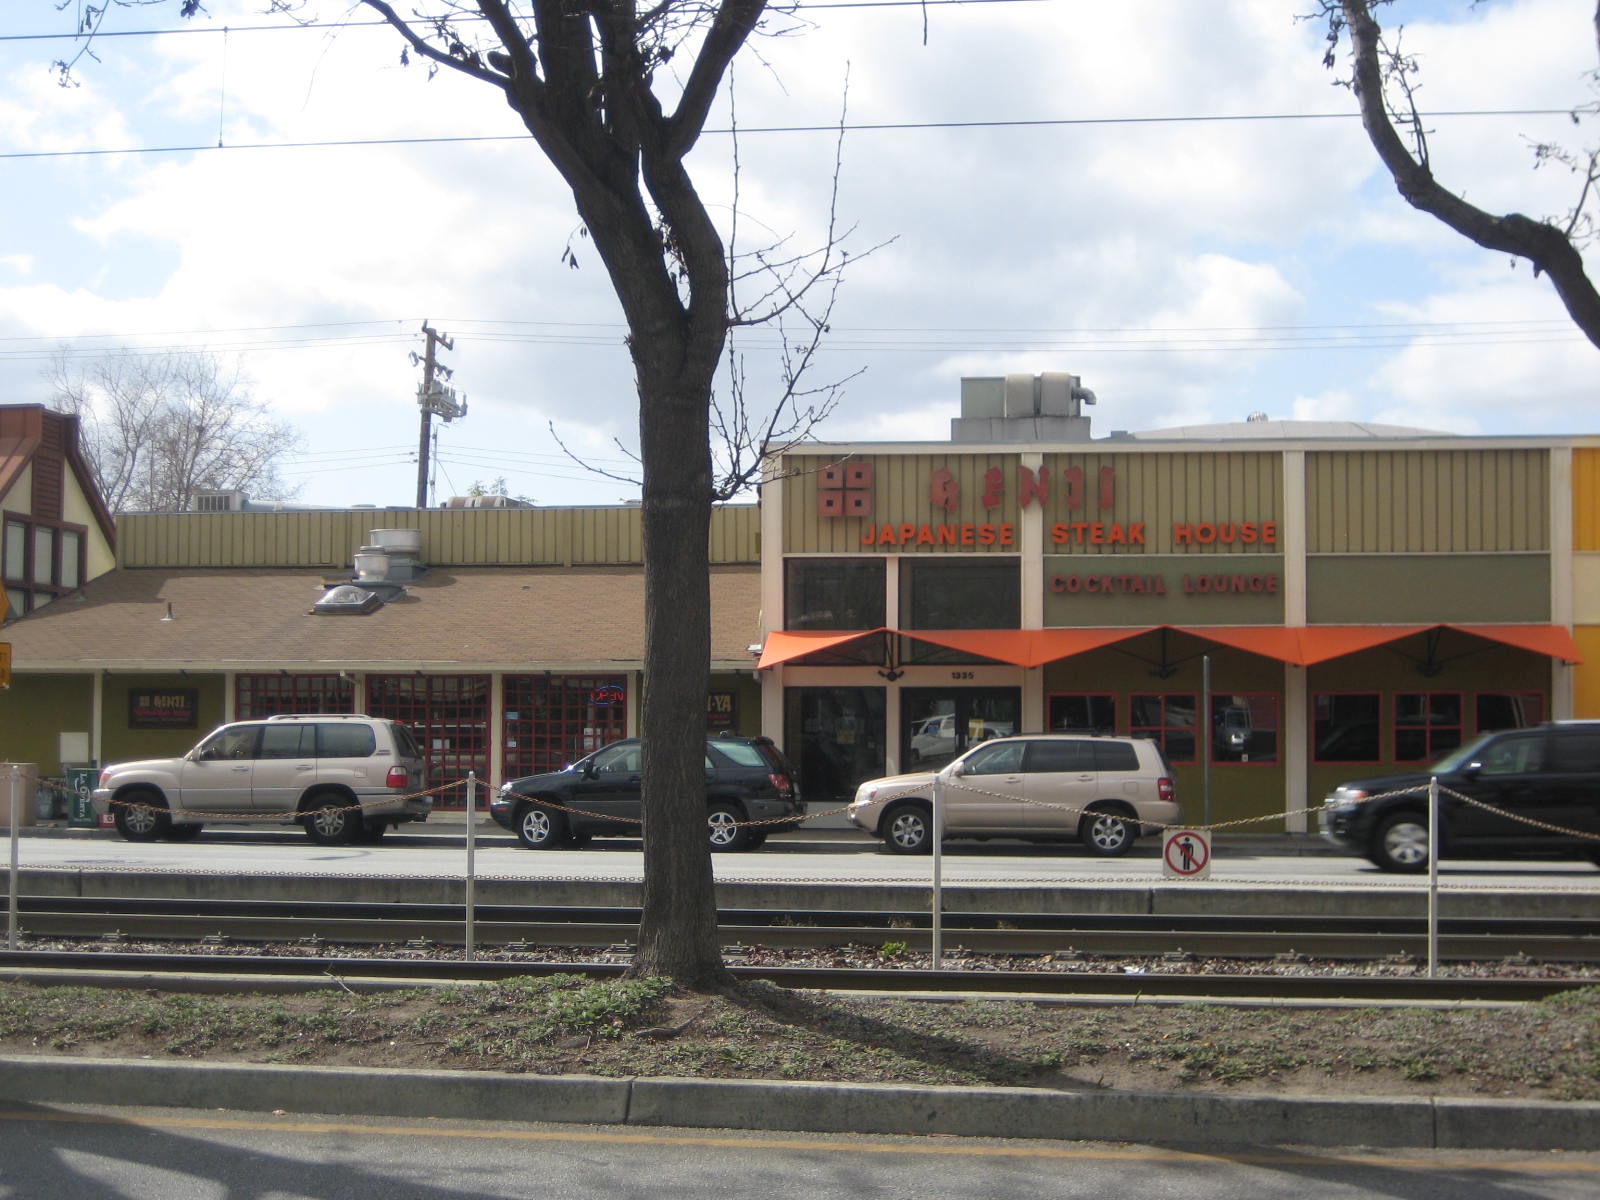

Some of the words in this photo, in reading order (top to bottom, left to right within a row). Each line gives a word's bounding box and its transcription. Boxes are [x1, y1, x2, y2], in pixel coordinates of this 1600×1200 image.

[929, 465, 1116, 512] GENJI
[861, 523, 1014, 545] JAPANESE
[1051, 522, 1146, 544] STEAK
[1174, 522, 1277, 544] HOUSE
[1051, 573, 1167, 594] COCKTAIL
[1183, 573, 1280, 594] LOUNGE
